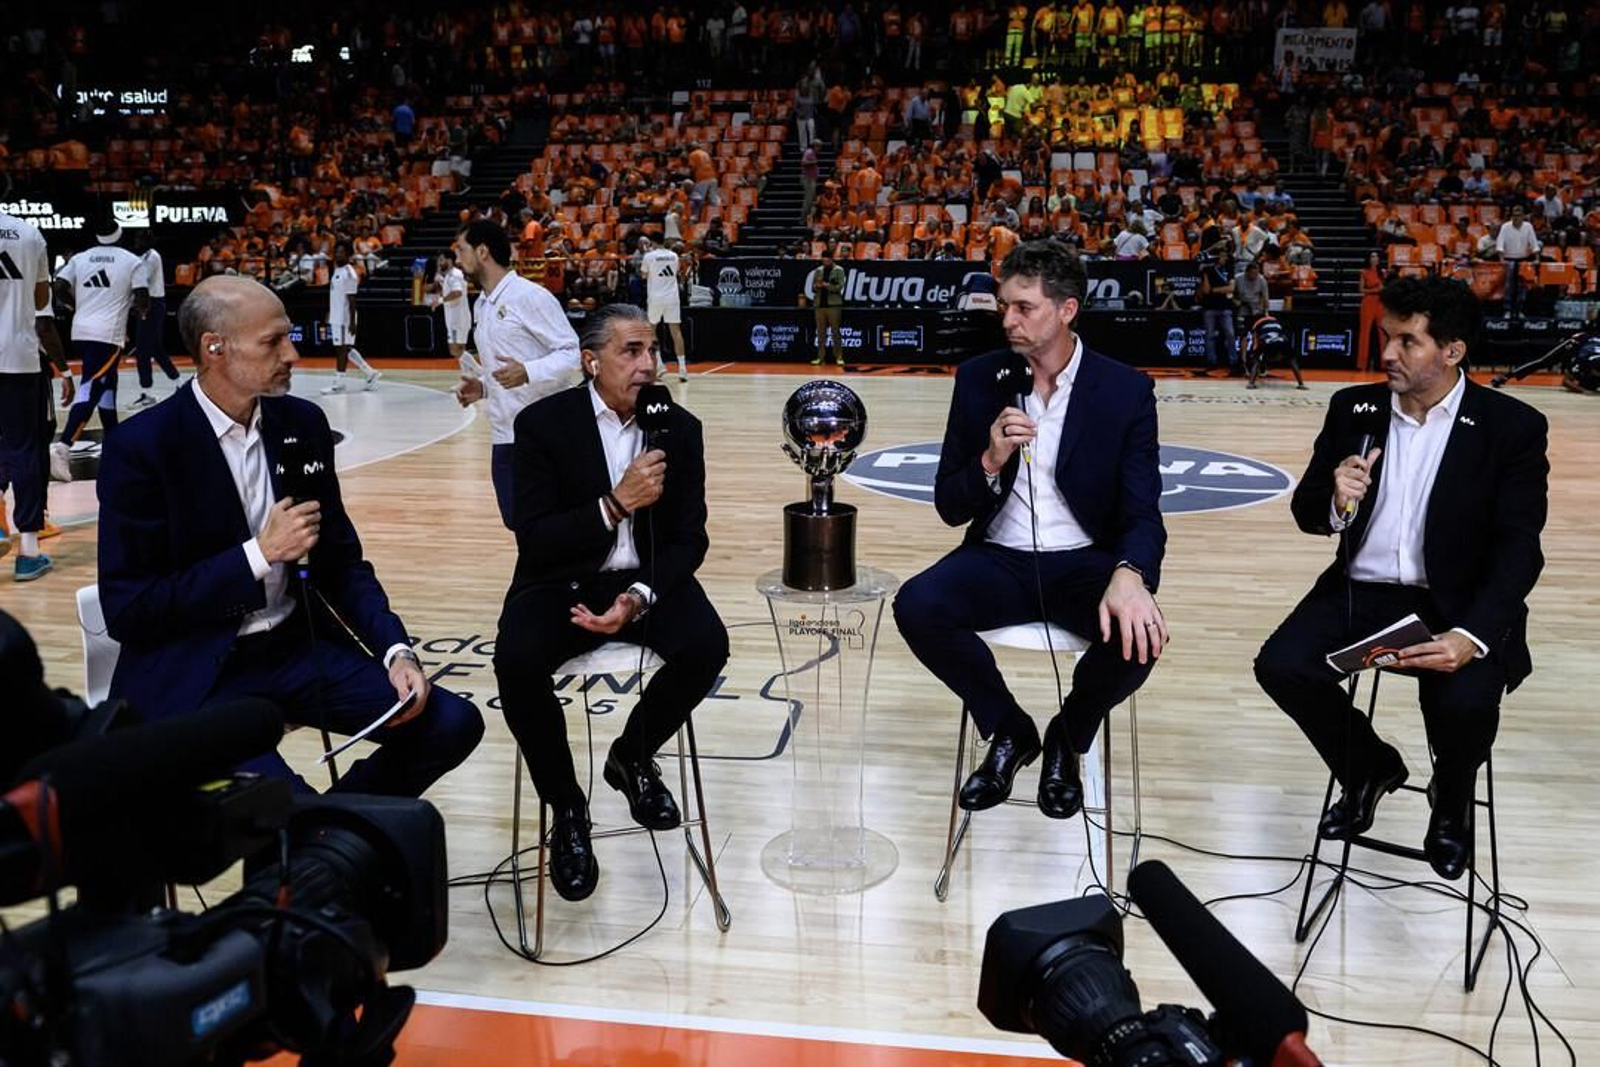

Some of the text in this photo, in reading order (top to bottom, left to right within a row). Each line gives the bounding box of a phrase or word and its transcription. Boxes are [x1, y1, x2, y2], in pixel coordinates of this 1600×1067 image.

[156, 204, 229, 223] PULEVA
[745, 267, 782, 278] valencia
[745, 279, 776, 289] basket
[771, 325, 799, 333] valencia
[771, 334, 795, 342] basket
[789, 628, 857, 636] PLAYOFF FINAL
